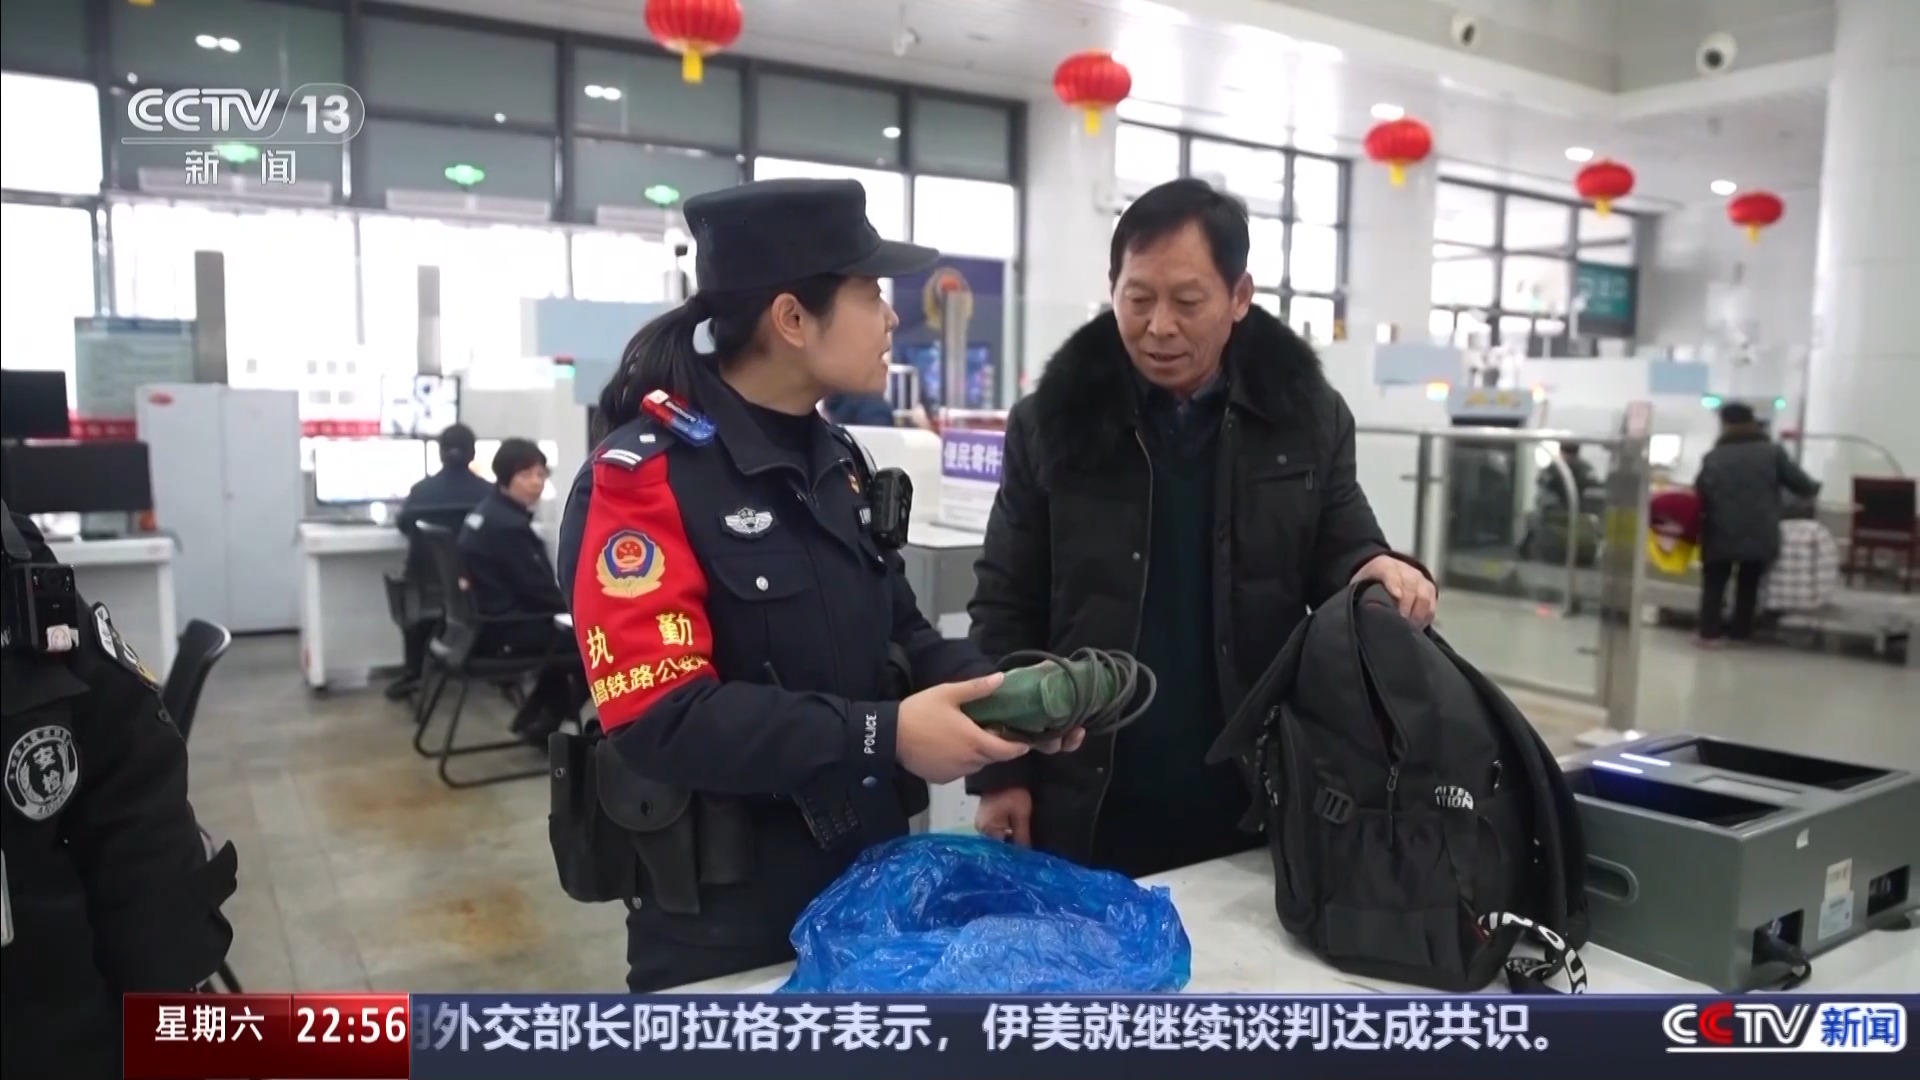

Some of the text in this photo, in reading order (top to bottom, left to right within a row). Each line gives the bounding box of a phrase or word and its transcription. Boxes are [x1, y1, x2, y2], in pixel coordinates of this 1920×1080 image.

[944, 441, 1003, 475] 便民寄件
[590, 655, 708, 707] 昌铁路公安
[863, 711, 877, 754] POLICE
